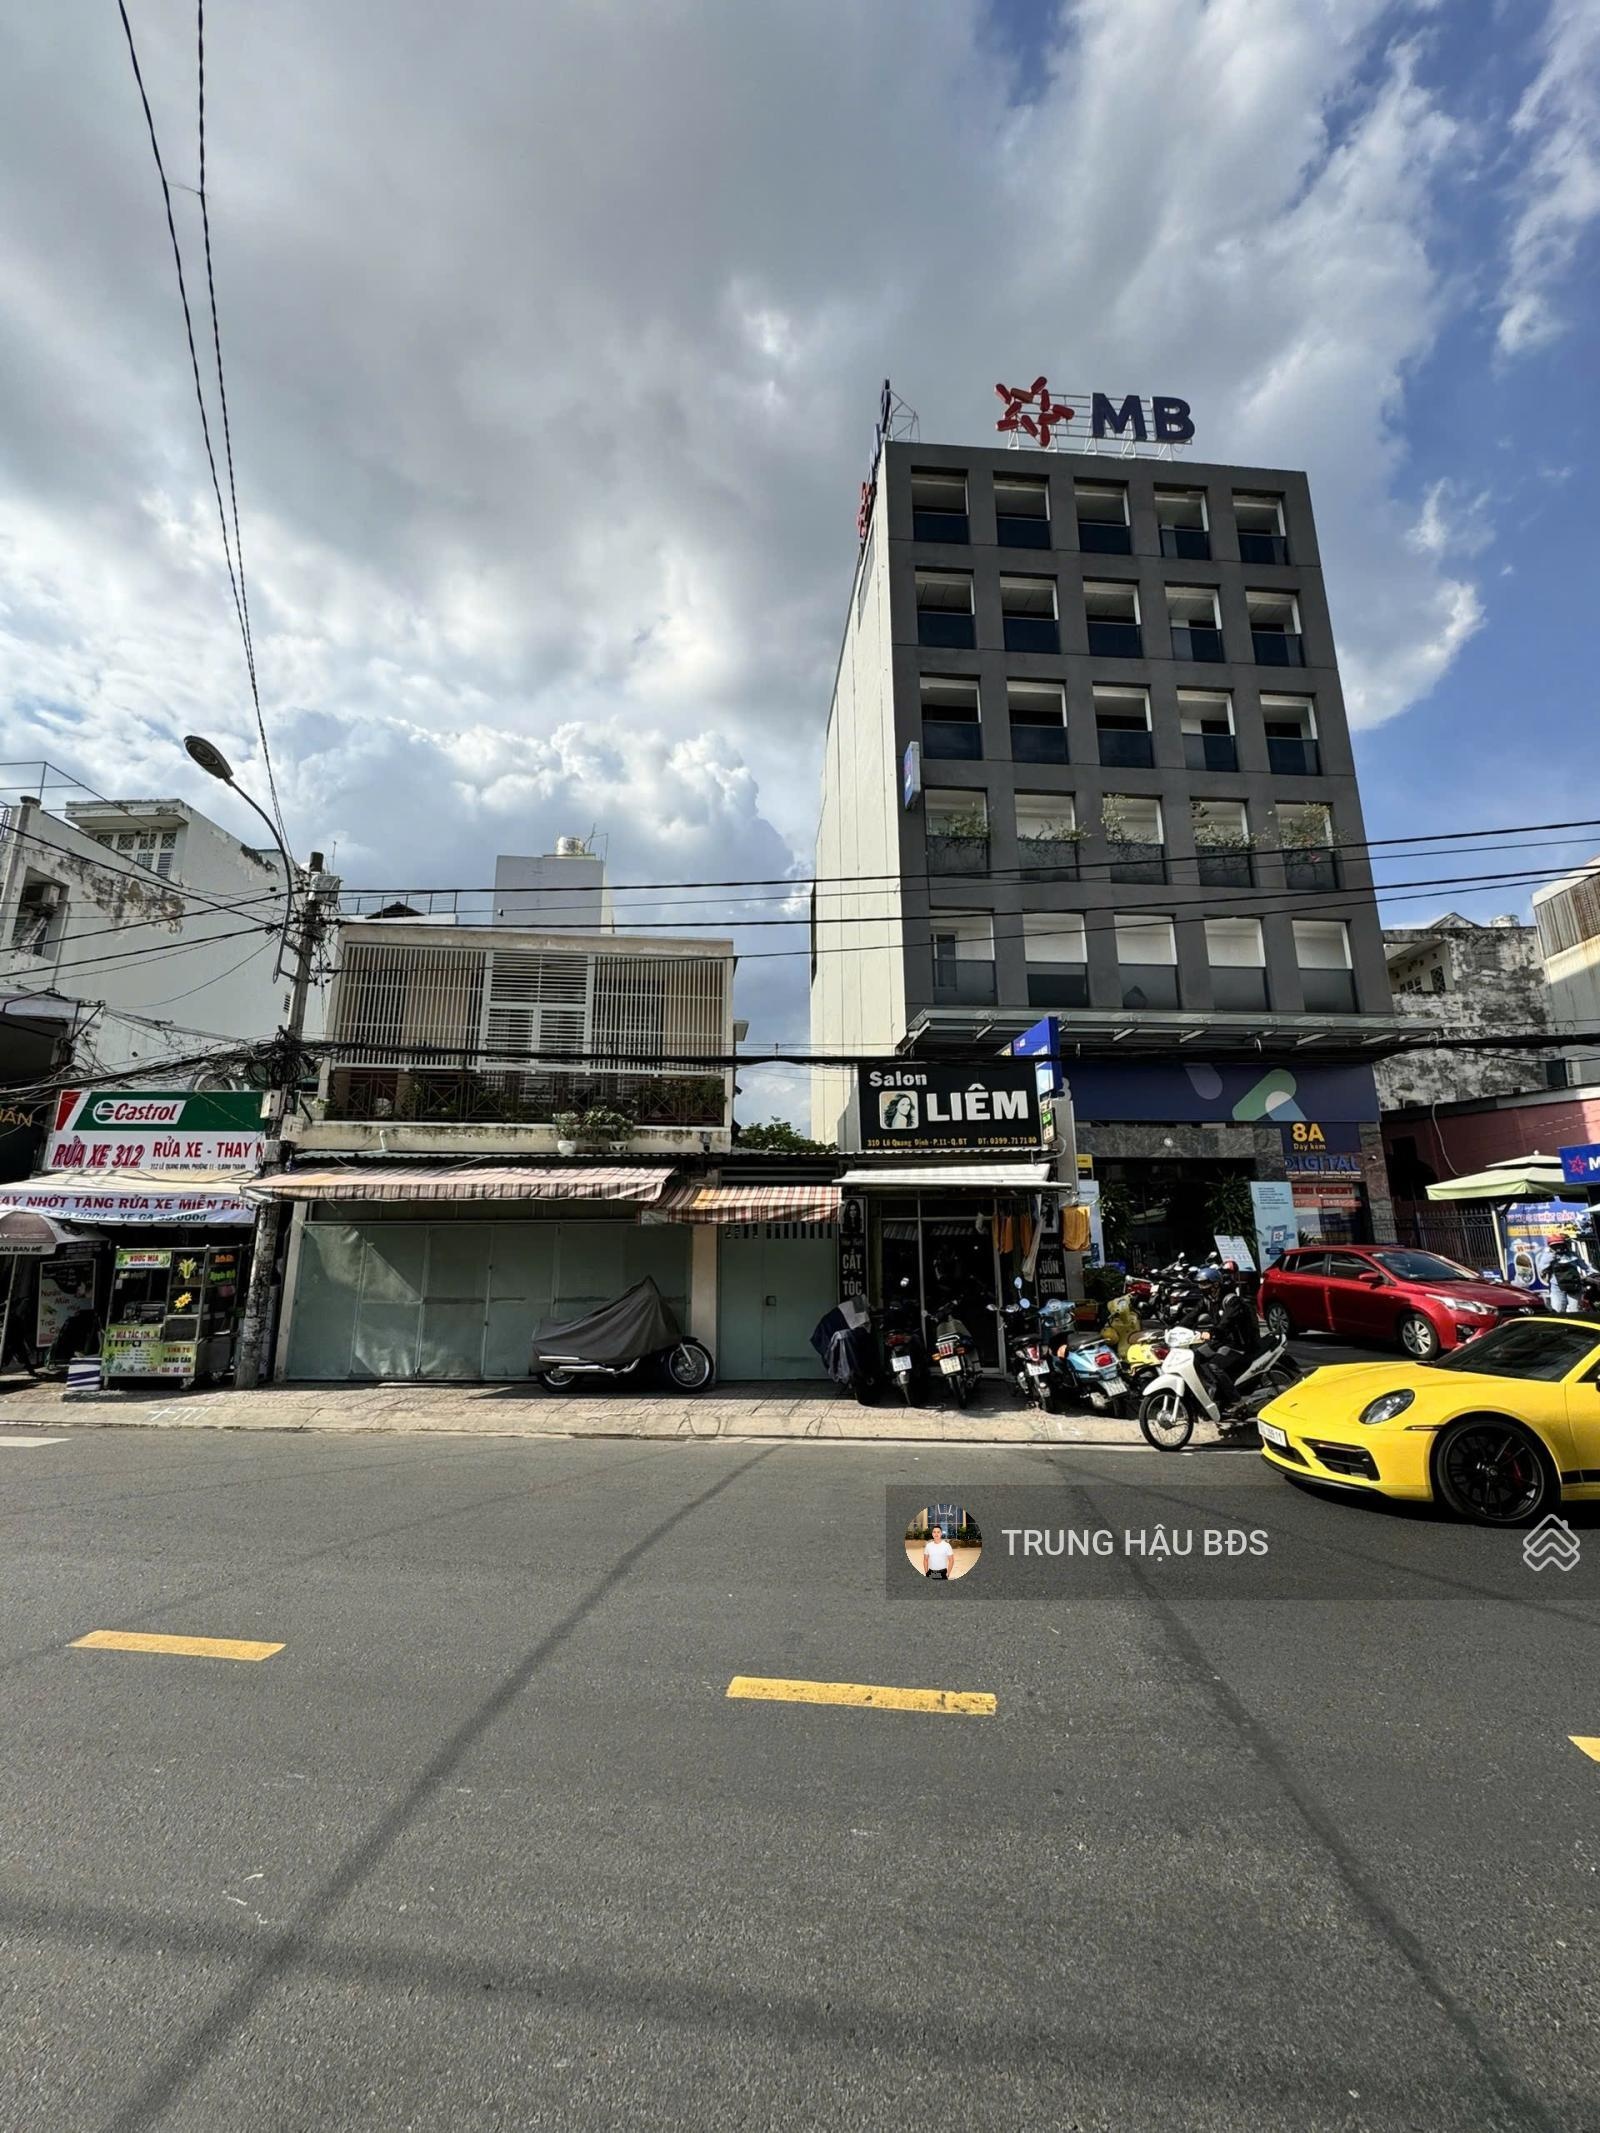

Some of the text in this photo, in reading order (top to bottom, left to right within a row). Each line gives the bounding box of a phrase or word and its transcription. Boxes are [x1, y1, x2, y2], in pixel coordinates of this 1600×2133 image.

[1092, 393, 1195, 443] MB
[869, 1071, 927, 1087] Salon
[114, 1103, 178, 1121] Castrol
[926, 1083, 1029, 1122] LIÊM
[1292, 1123, 1325, 1142] 8A
[52, 1135, 145, 1168] RỬA XE 312
[153, 1135, 180, 1158] RỬA
[185, 1142, 203, 1158] XE
[216, 1142, 252, 1159] THAY
[1285, 1154, 1361, 1171] DIGITAL
[26, 1194, 69, 1208] NHỚT
[74, 1195, 114, 1212] TẶNG
[118, 1193, 149, 1210] RỬA
[154, 1198, 174, 1209] XE
[178, 1192, 217, 1210] MIỄN
[843, 1248, 862, 1270] CẮT
